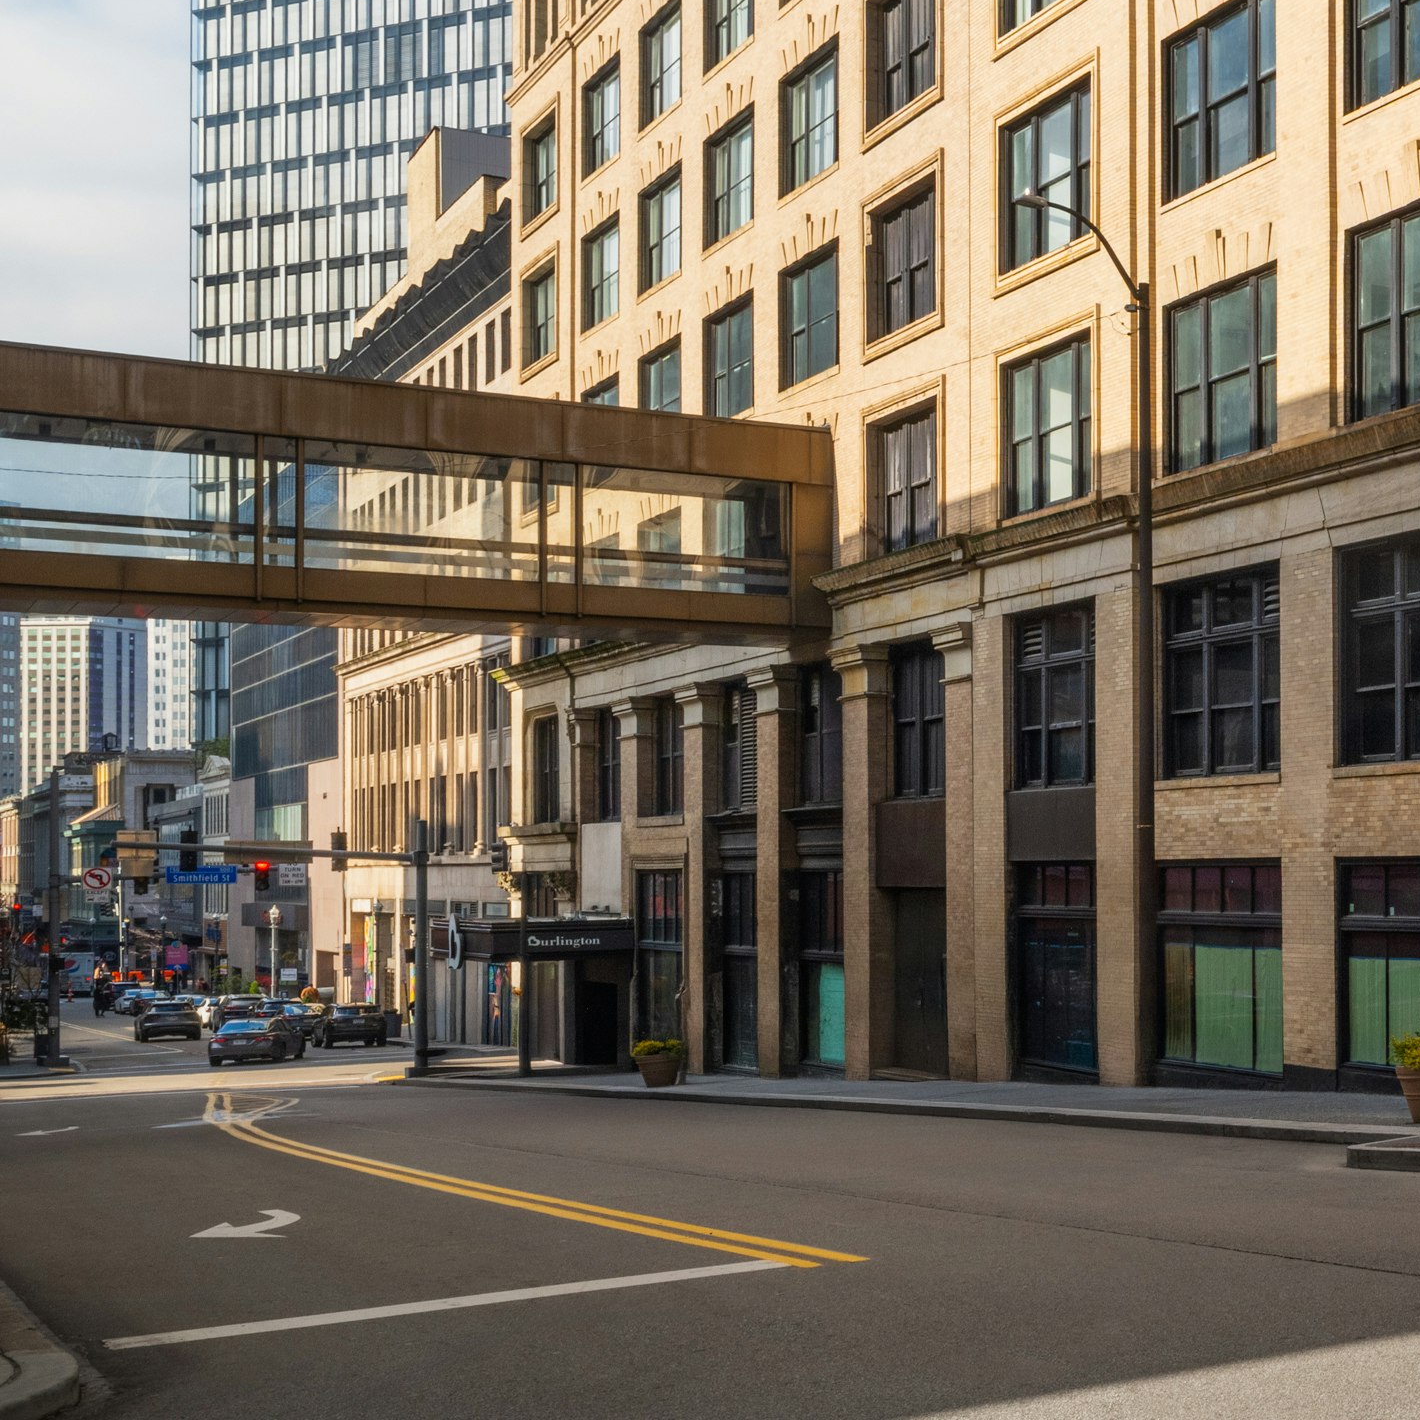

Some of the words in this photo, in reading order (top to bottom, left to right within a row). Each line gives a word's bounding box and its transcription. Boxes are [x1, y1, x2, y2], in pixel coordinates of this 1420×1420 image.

[173, 874, 218, 883] Smithfield
[222, 874, 230, 882] St
[528, 935, 600, 948] Burlington
